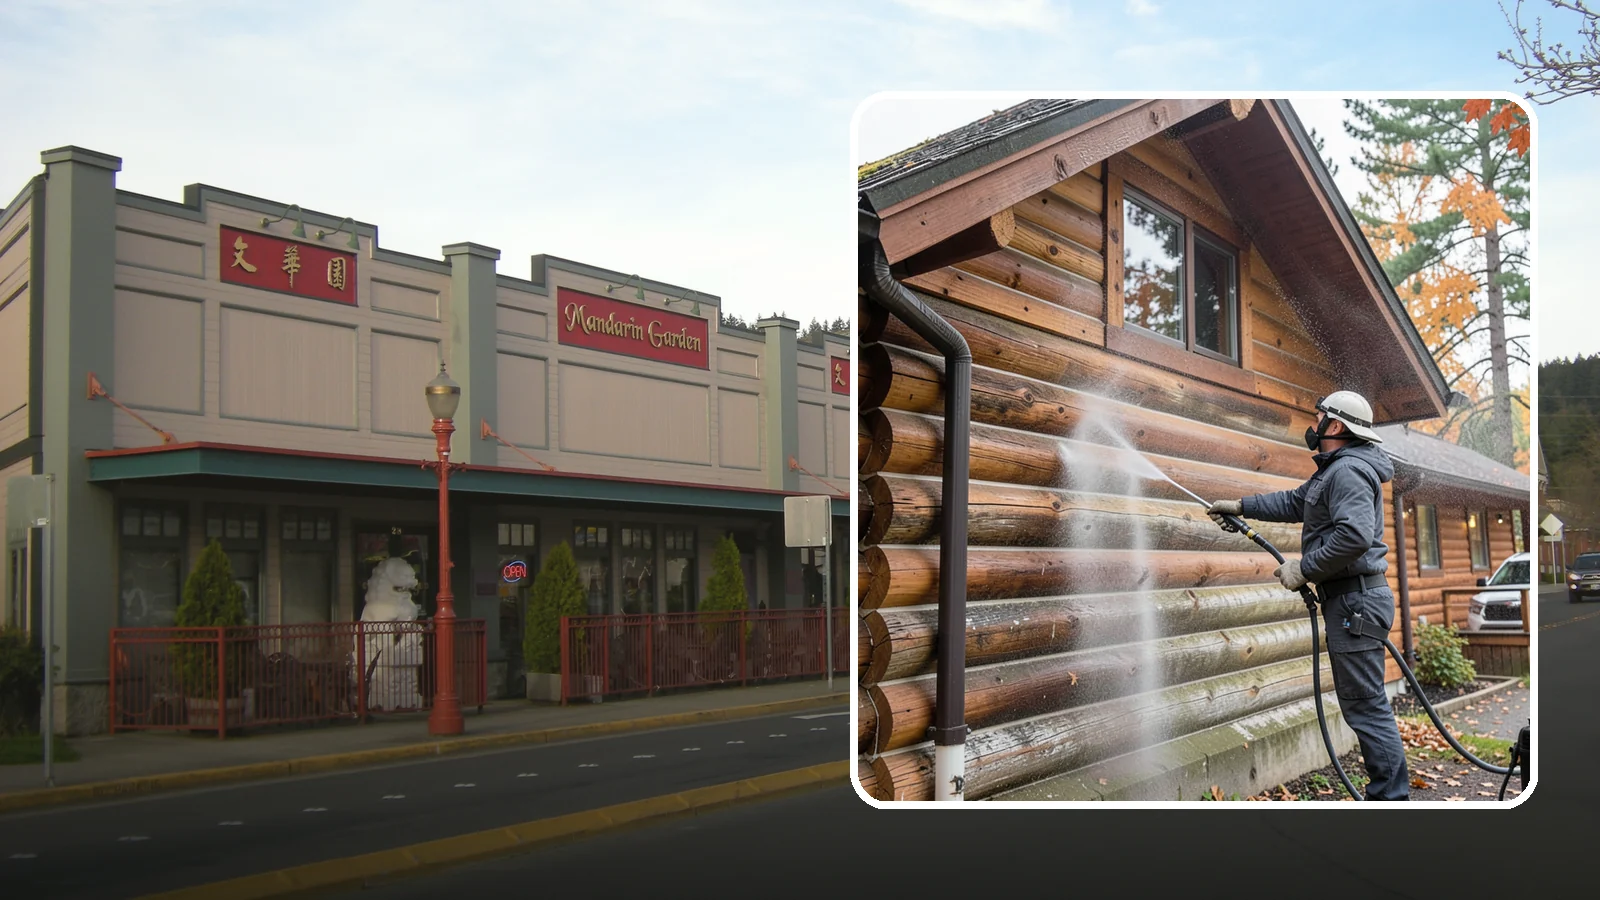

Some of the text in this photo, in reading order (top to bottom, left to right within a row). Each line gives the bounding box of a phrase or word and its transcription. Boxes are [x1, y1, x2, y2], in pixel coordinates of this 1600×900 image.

[231, 236, 346, 290] 文華園
[564, 302, 701, 352] Mandarin Garden
[503, 565, 527, 578] OPEN
